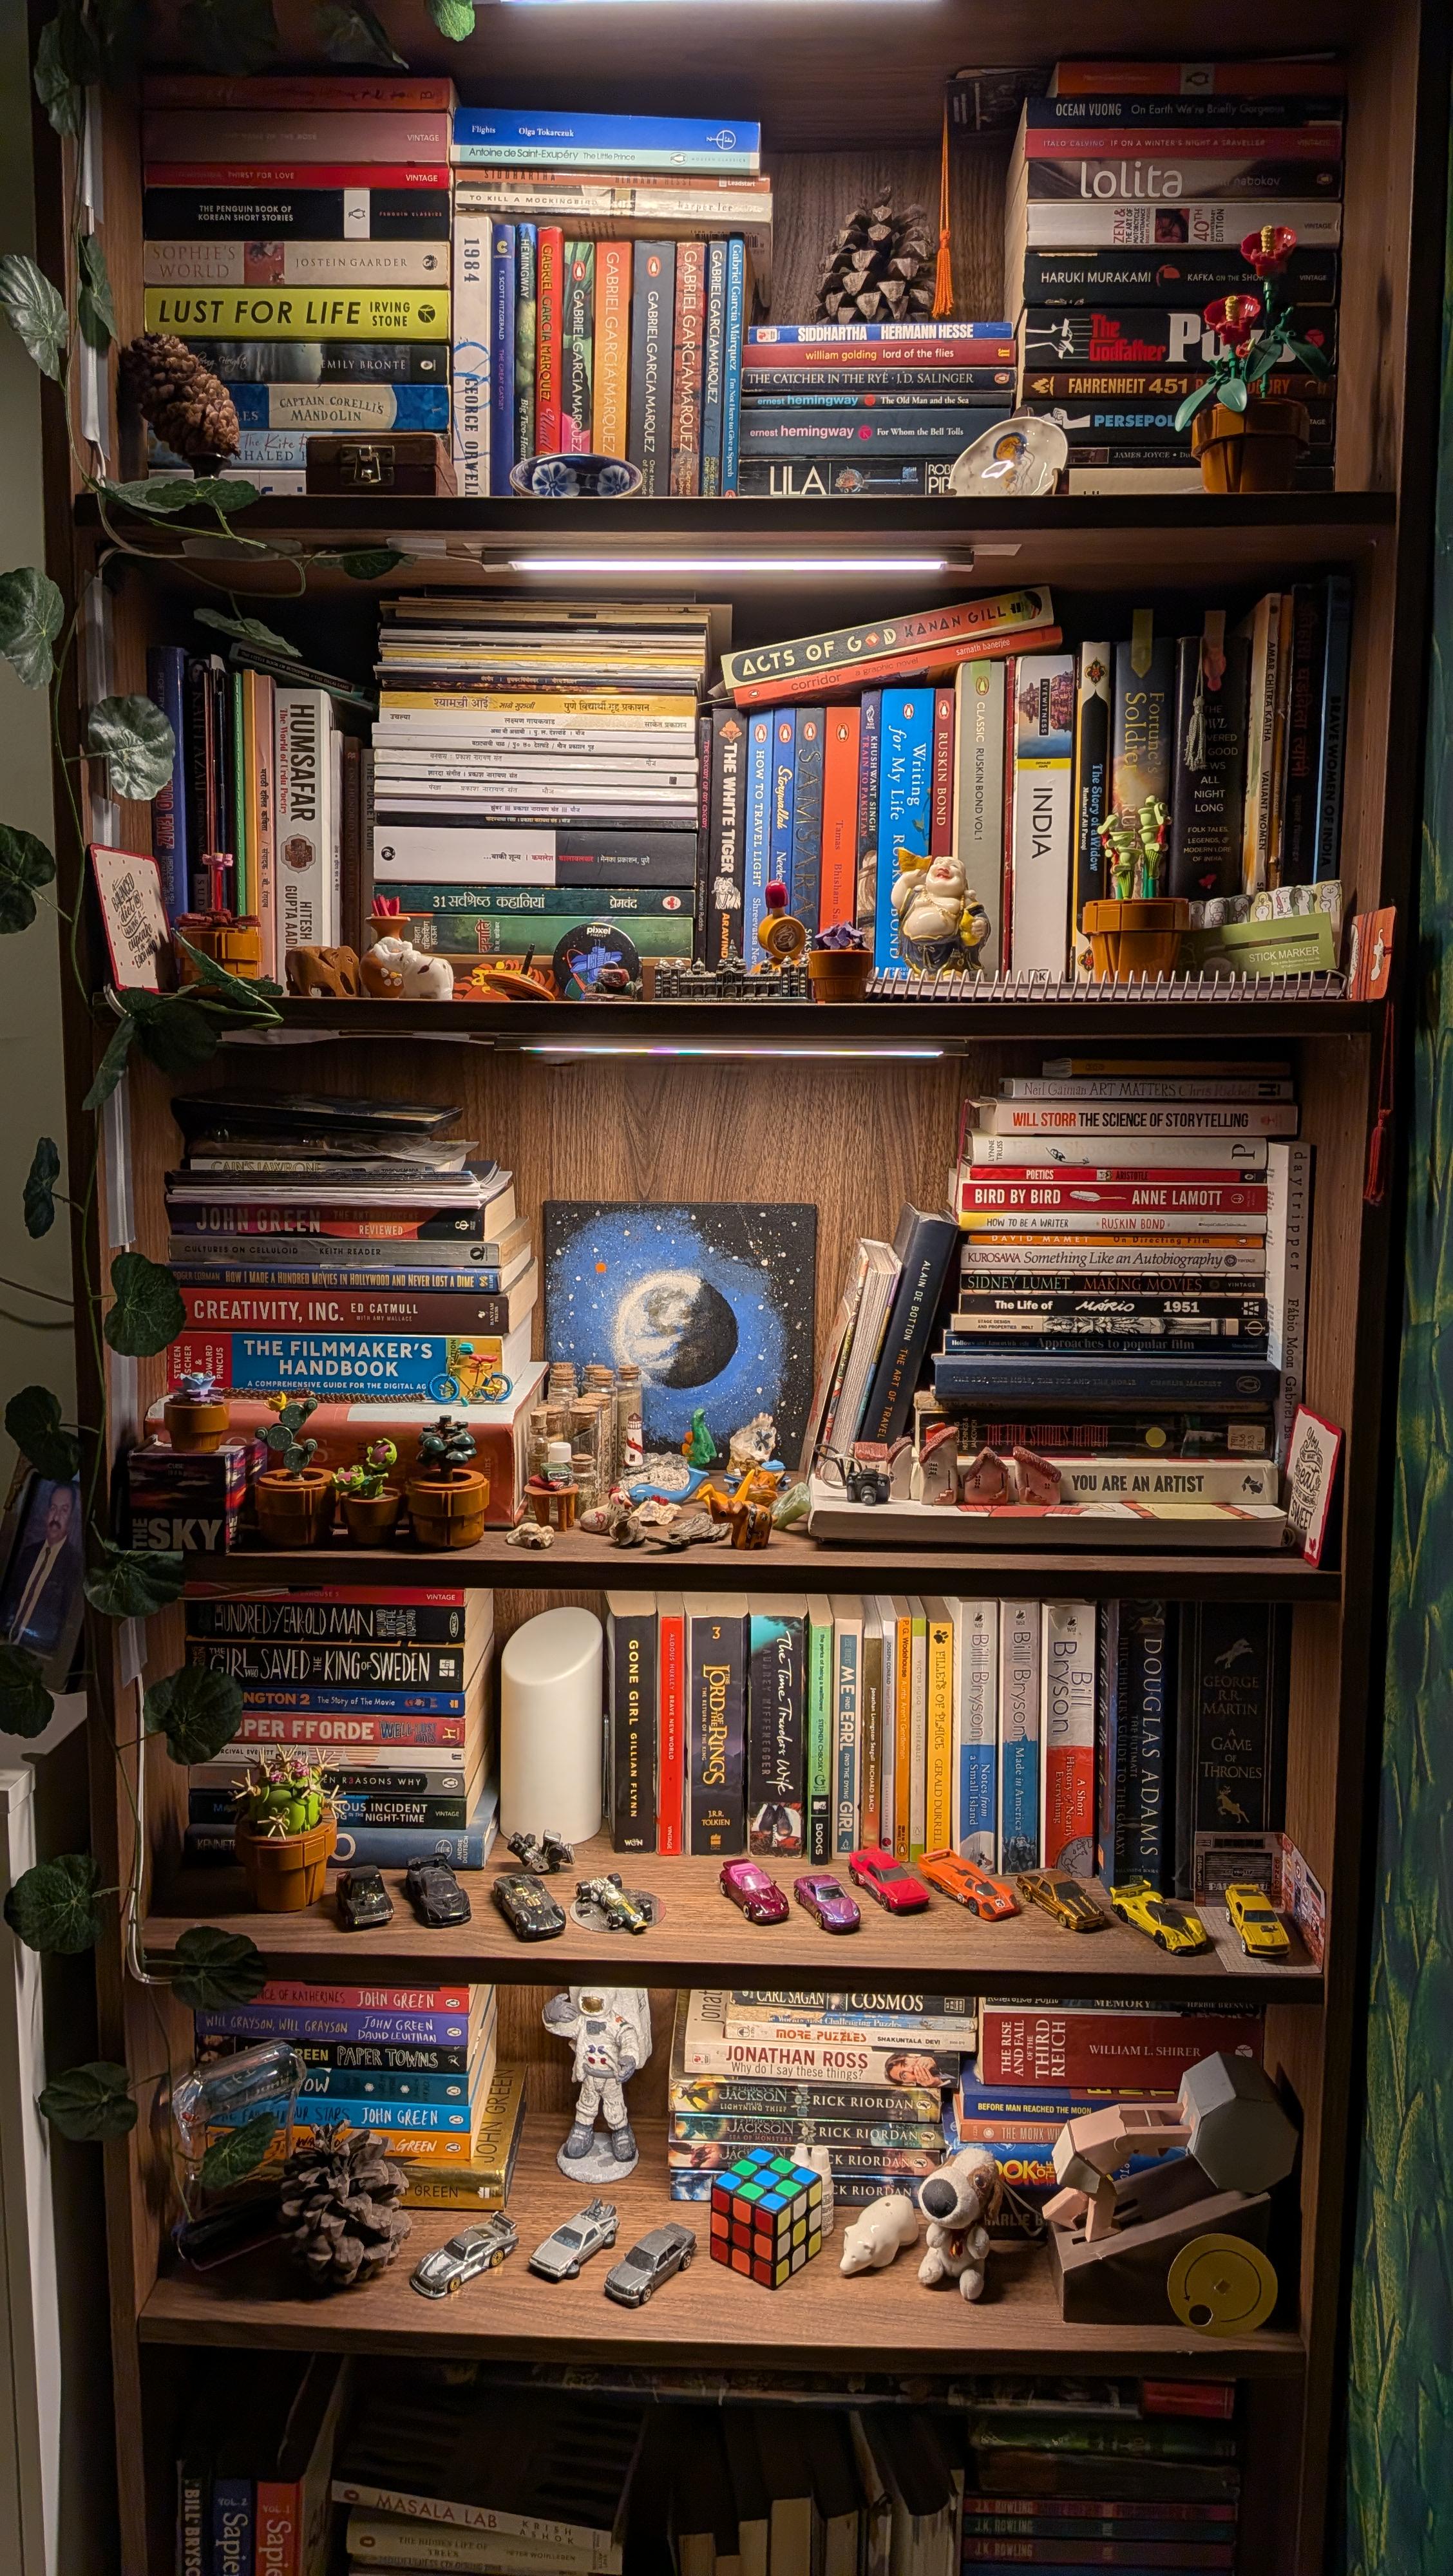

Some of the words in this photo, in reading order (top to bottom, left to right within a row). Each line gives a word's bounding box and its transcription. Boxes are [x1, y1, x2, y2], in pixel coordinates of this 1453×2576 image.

[472, 126, 496, 135] Flights
[519, 128, 535, 137] Olga
[537, 129, 574, 138] Tokarczuk
[1081, 161, 1182, 198] lolita
[296, 258, 346, 267] JOSTEIN
[351, 258, 406, 267] GAARDER
[464, 238, 480, 283] 1984
[520, 239, 529, 298] HEMINGWAY
[605, 252, 619, 314] GABRIEL
[1041, 272, 1084, 283] HARUKI
[1088, 272, 1151, 283] MURAKAMI
[159, 301, 223, 323] LUST
[235, 301, 292, 324] FOR
[307, 301, 361, 325] LIFE
[370, 302, 410, 313] IRVING
[372, 316, 407, 327] STONE
[798, 327, 867, 341] SIDDHARTHA
[881, 325, 936, 339] HERMANN
[938, 325, 974, 339] HESSE
[604, 316, 618, 377] GARCÍA
[806, 350, 840, 360] william
[842, 349, 877, 361] golding
[883, 348, 900, 358] lord
[904, 348, 915, 358] of
[916, 348, 931, 358] the
[935, 348, 954, 358] flies
[1068, 378, 1145, 393] FAHRENHEIT
[1149, 379, 1188, 393] 451
[787, 395, 858, 406] hemingway
[603, 379, 616, 453] MÁRQUEZ
[770, 466, 826, 495] LILA
[968, 607, 1007, 625] GILL
[806, 641, 835, 661] OF
[982, 639, 1011, 651] banerjee
[792, 673, 841, 691] corridor
[290, 704, 316, 822] HUMSAFAR
[723, 743, 737, 772] THE
[937, 732, 948, 782] RUSKIN
[722, 776, 736, 827] WHITE
[937, 785, 945, 826] BOND
[1032, 788, 1052, 859] INDIA
[721, 830, 734, 873] TIGER
[433, 896, 446, 908] 31
[721, 913, 729, 958] ARAVIND
[1249, 952, 1277, 963] STICK
[1279, 946, 1320, 960] MARKER
[1013, 1113, 1038, 1127] WILL
[1041, 1112, 1076, 1126] STORR
[1079, 1113, 1099, 1126] THE
[1103, 1113, 1147, 1126] SCIENCE
[1150, 1113, 1163, 1126] OF
[1166, 1113, 1248, 1127] STORYTELLING
[975, 1189, 1005, 1204] BIRD
[1011, 1189, 1025, 1204] BY
[1031, 1189, 1061, 1204] BIRD
[1132, 1190, 1167, 1206] ANNE
[1172, 1190, 1222, 1206] LAMOTT
[968, 1253, 1021, 1263] KUROSAWA
[1023, 1251, 1087, 1266] Something
[1089, 1252, 1114, 1265] Like
[1116, 1255, 1131, 1265] an
[1135, 1253, 1222, 1269] Autobiography
[917, 1261, 931, 1287] ALAIN
[913, 1291, 923, 1302] DE
[995, 1301, 1015, 1309] The
[1018, 1301, 1040, 1309] Life
[1041, 1301, 1052, 1309] of
[194, 1301, 303, 1323] CREATIVITY,
[309, 1302, 343, 1321] INC.
[350, 1303, 366, 1313] ED
[370, 1302, 418, 1314] CATMULL
[1163, 1302, 1199, 1312] 1951
[903, 1305, 919, 1341] BOTTON
[244, 1340, 285, 1356] THE
[290, 1340, 432, 1358] FILMMAKER'S
[279, 1360, 398, 1376] HANDBOOK
[1072, 1476, 1097, 1492] YOU
[1101, 1476, 1128, 1492] ARE
[1132, 1476, 1150, 1492] AN
[1154, 1475, 1204, 1492] ARTIST
[971, 1634, 989, 1669] Bill
[629, 1640, 638, 1684] GONE
[629, 1691, 638, 1725] GIRL
[969, 1672, 989, 1739] Bryson
[1141, 1638, 1162, 1759] DOUGLAS
[292, 1722, 374, 1740] FFORDE
[1015, 1747, 1024, 1775] Made
[1200, 1763, 1262, 1778] THRONES
[934, 1758, 943, 1797] GERALD
[1015, 1777, 1024, 1786] in
[365, 1814, 424, 1823] NIGHT-TIME
[371, 1804, 428, 1814] INCIDENT
[1015, 1789, 1024, 1831] America
[1141, 1769, 1159, 1855] ADAMS
[934, 1799, 942, 1843] DURRELL
[357, 1994, 387, 2007] JOHN
[394, 1994, 434, 2008] GREEN
[337, 2046, 381, 2066] PAPER
[386, 2049, 438, 2068] TOWNS
[726, 2046, 815, 2065] JONATHAN
[823, 2052, 868, 2069] ROSS
[1036, 2019, 1050, 2078] THIRD
[1051, 2021, 1066, 2077] REICH
[1089, 2045, 1141, 2056] WILLIAM
[1156, 2046, 1201, 2057] SHIRER
[732, 2062, 750, 2074] Why
[754, 2065, 766, 2074] do
[777, 2067, 793, 2076] say
[797, 2067, 823, 2077] these
[827, 2069, 863, 2080] things?
[813, 2096, 844, 2106] RICK
[851, 2098, 913, 2108] RIORDAN
[1023, 2105, 1054, 2113] REACHED
[1071, 2107, 1092, 2115] MOON
[377, 2494, 455, 2522] MASALA
[465, 2509, 497, 2528] LAB
